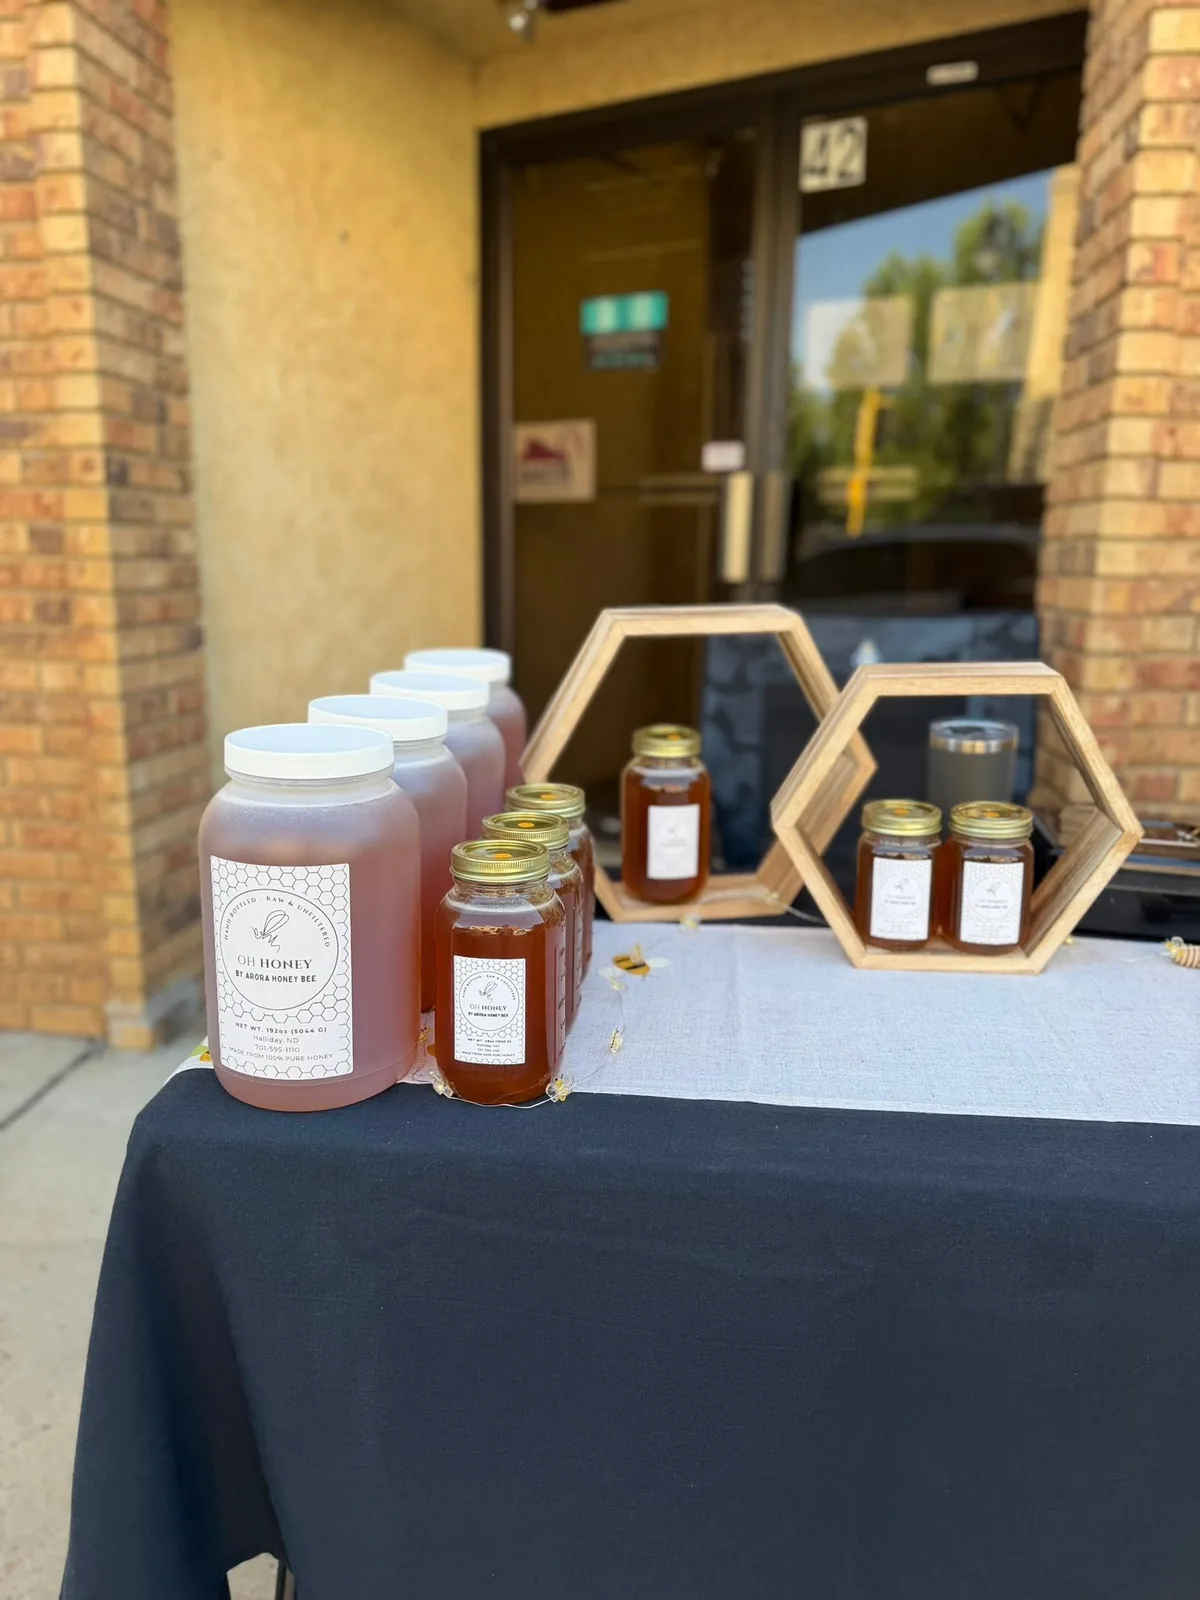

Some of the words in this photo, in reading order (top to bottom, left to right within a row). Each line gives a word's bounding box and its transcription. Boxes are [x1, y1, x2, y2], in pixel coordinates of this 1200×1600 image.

[801, 125, 866, 185] 42
[230, 897, 256, 917] BOTTLED
[297, 905, 330, 947] UNFILTERED
[238, 955, 255, 966] OH
[260, 959, 312, 969] HONEY
[245, 972, 270, 981] ARORA
[272, 975, 298, 983] HONEY
[253, 1035, 284, 1044] Halliday,
[229, 1046, 244, 1054] MADE
[246, 1051, 264, 1059] FROM
[307, 1053, 333, 1061] HONEY
[255, 1044, 300, 1053] 701-595-1110
